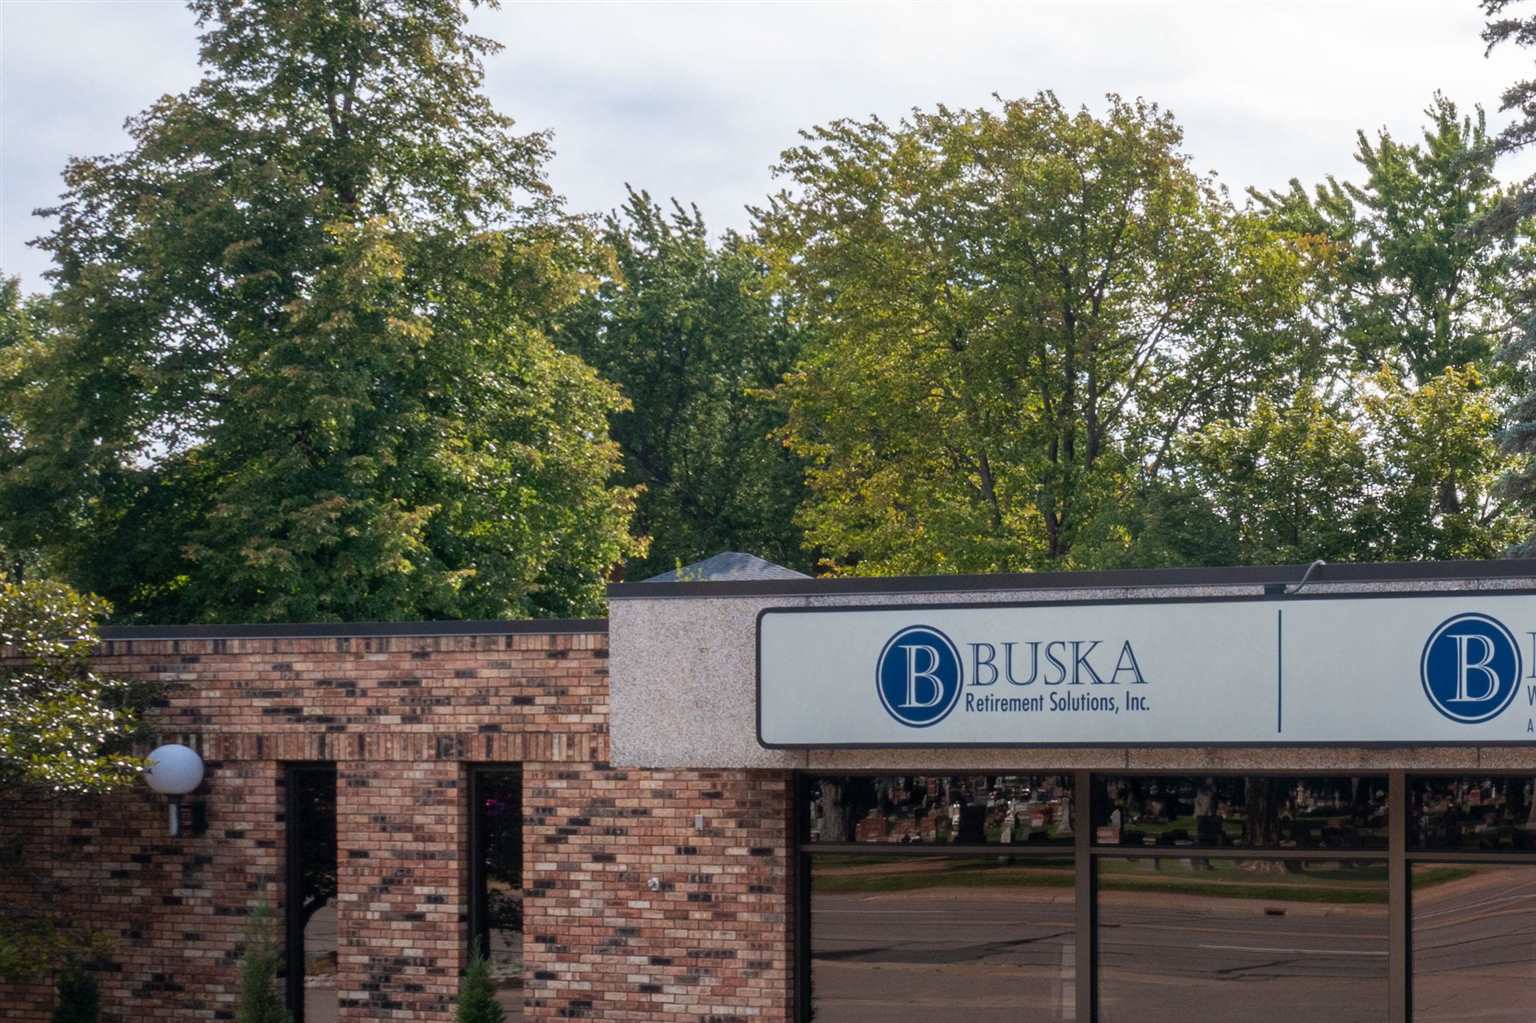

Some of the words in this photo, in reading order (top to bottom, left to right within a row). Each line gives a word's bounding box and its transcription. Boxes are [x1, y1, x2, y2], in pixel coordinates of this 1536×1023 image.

[897, 643, 944, 708] B
[967, 640, 1149, 687] BUSKA
[1446, 633, 1501, 702] B
[965, 692, 1045, 713] Retirement
[1049, 690, 1120, 715] Solutions,
[1126, 690, 1151, 712] Inc.
[1526, 718, 1535, 733] A
